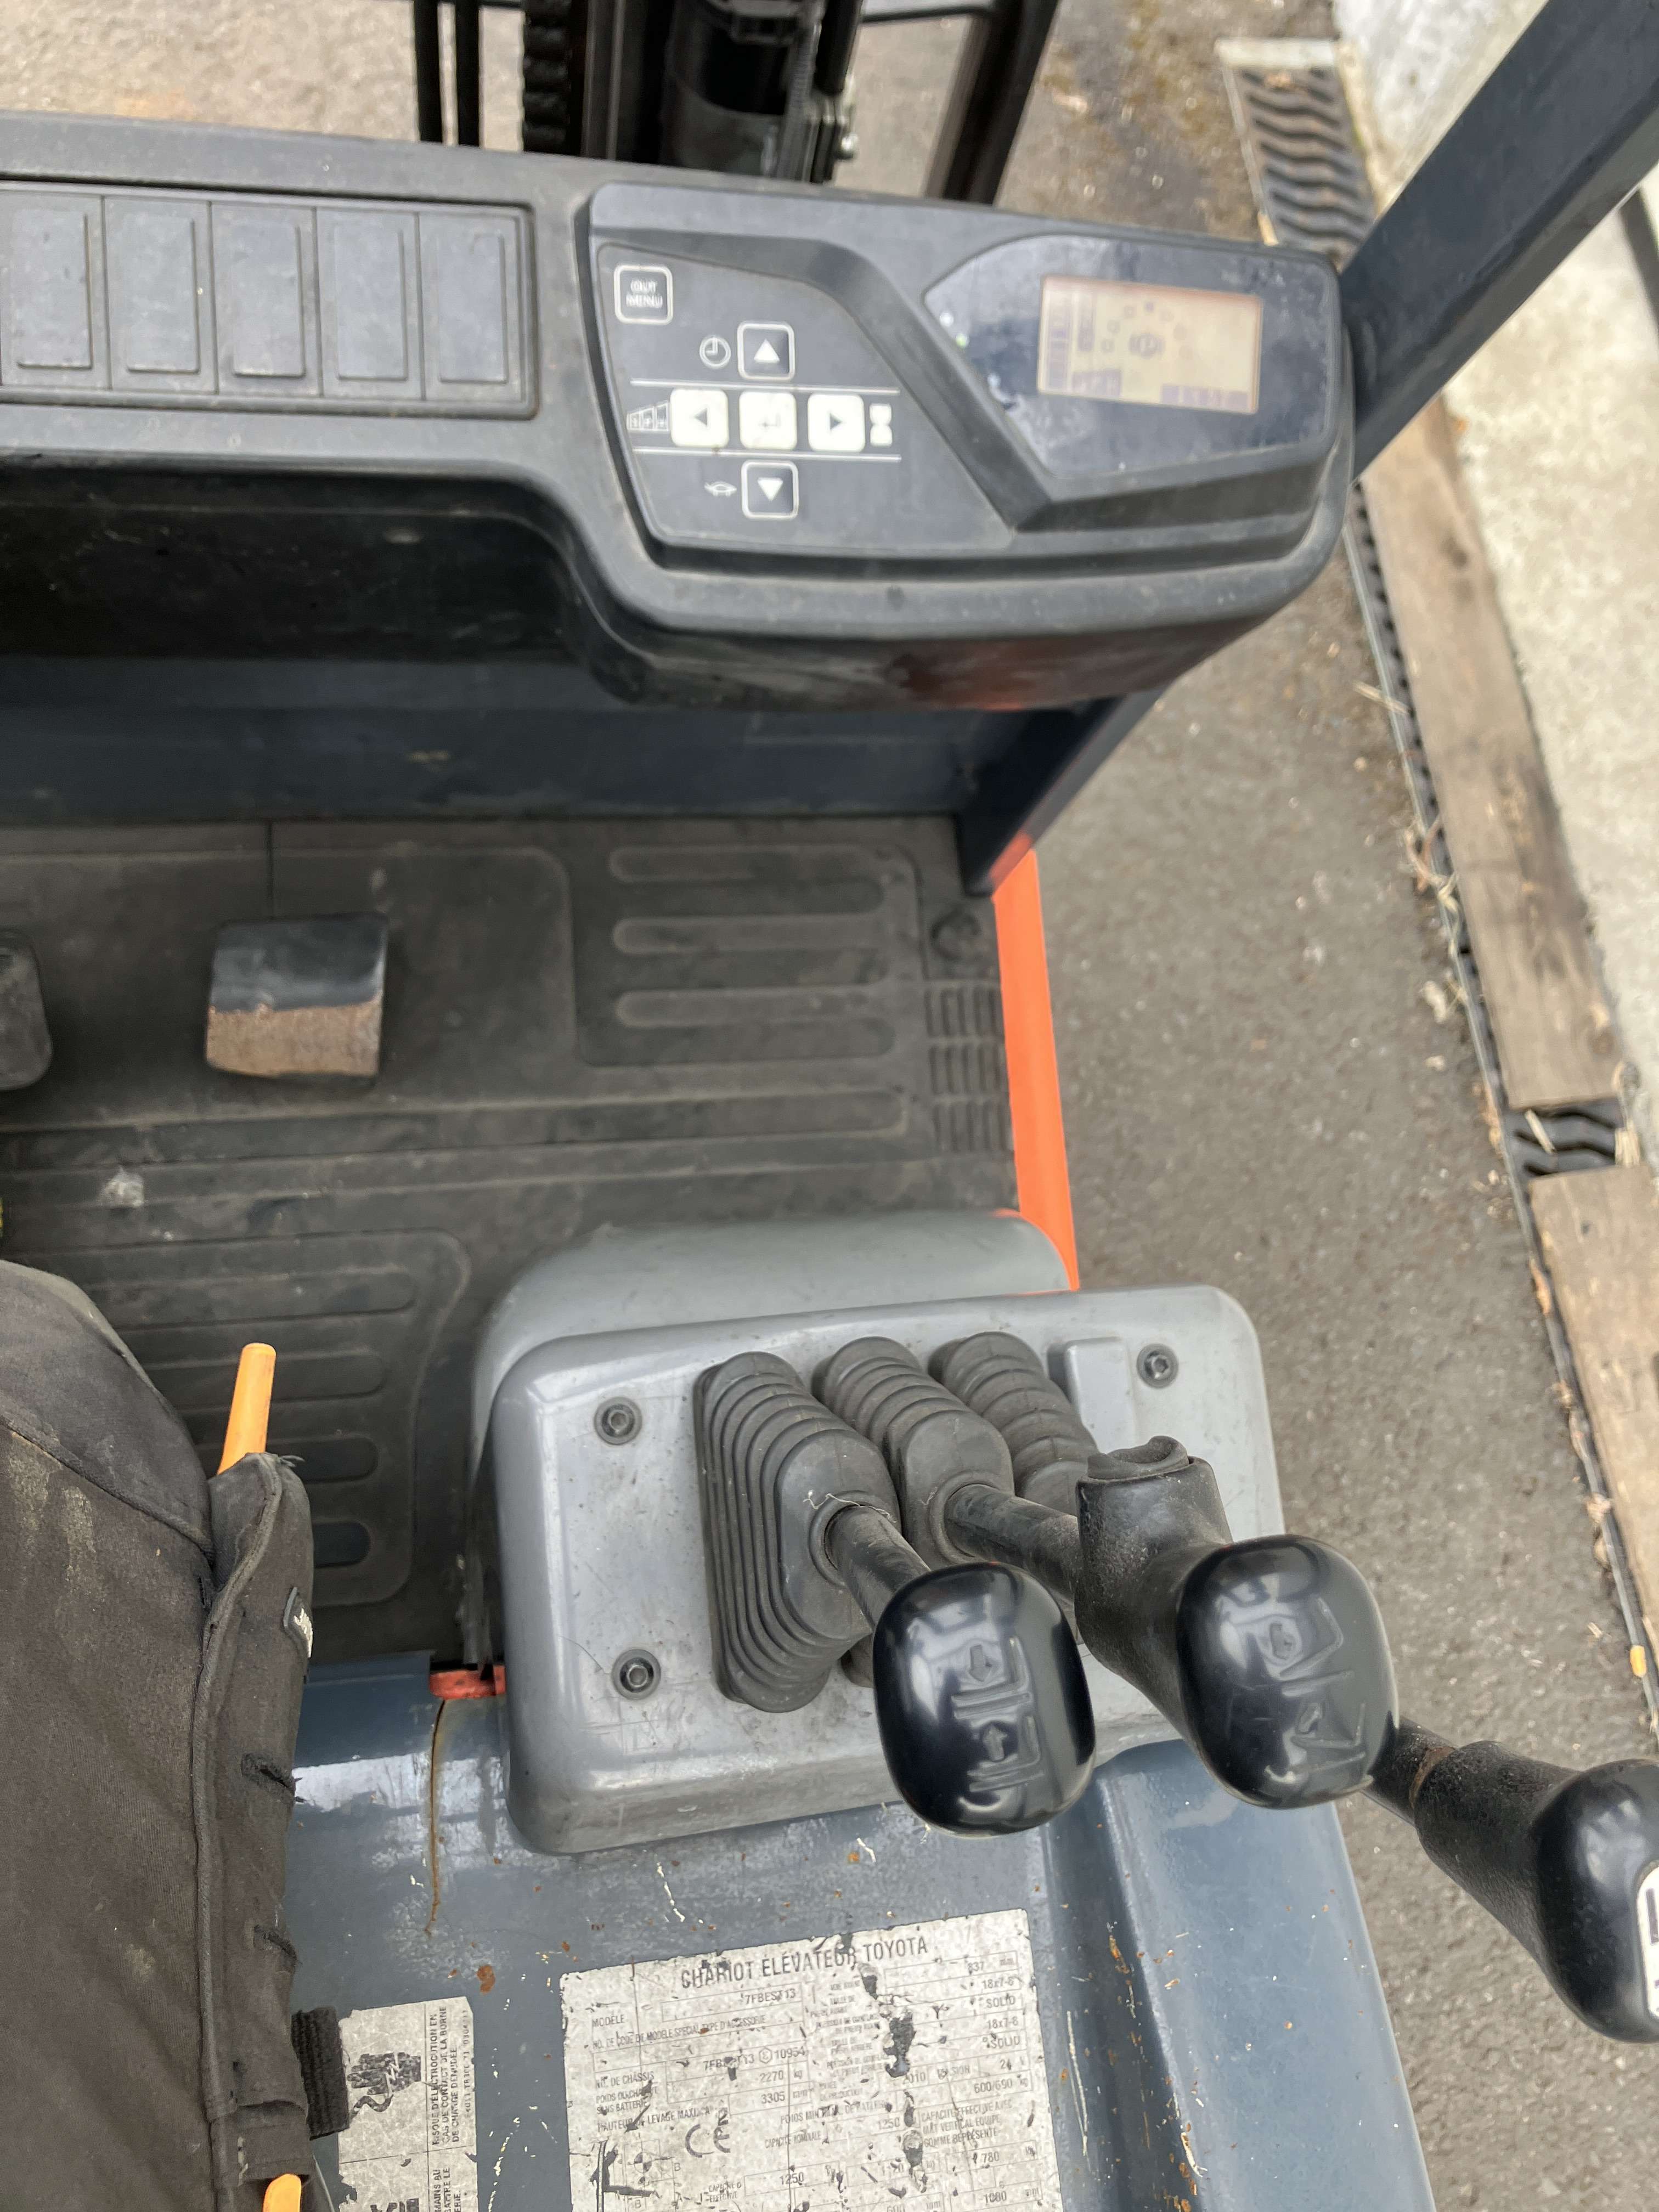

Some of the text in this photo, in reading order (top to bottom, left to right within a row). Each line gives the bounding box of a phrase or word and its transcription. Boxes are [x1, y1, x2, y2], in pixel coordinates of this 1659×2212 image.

[681, 1960, 754, 1989] CHARIOT
[863, 1936, 928, 1961] TOYOTA
[968, 1961, 985, 1972] 837
[986, 1995, 1015, 2008] SOLID
[439, 2006, 447, 2036] BORNE
[439, 2039, 447, 2050] LA
[759, 2070, 784, 2083] 2270
[761, 2091, 786, 2104] 3305
[452, 2130, 459, 2142] DE
[685, 2124, 731, 2158] CE
[443, 2167, 450, 2179] LE
[780, 2171, 804, 2185] 1250
